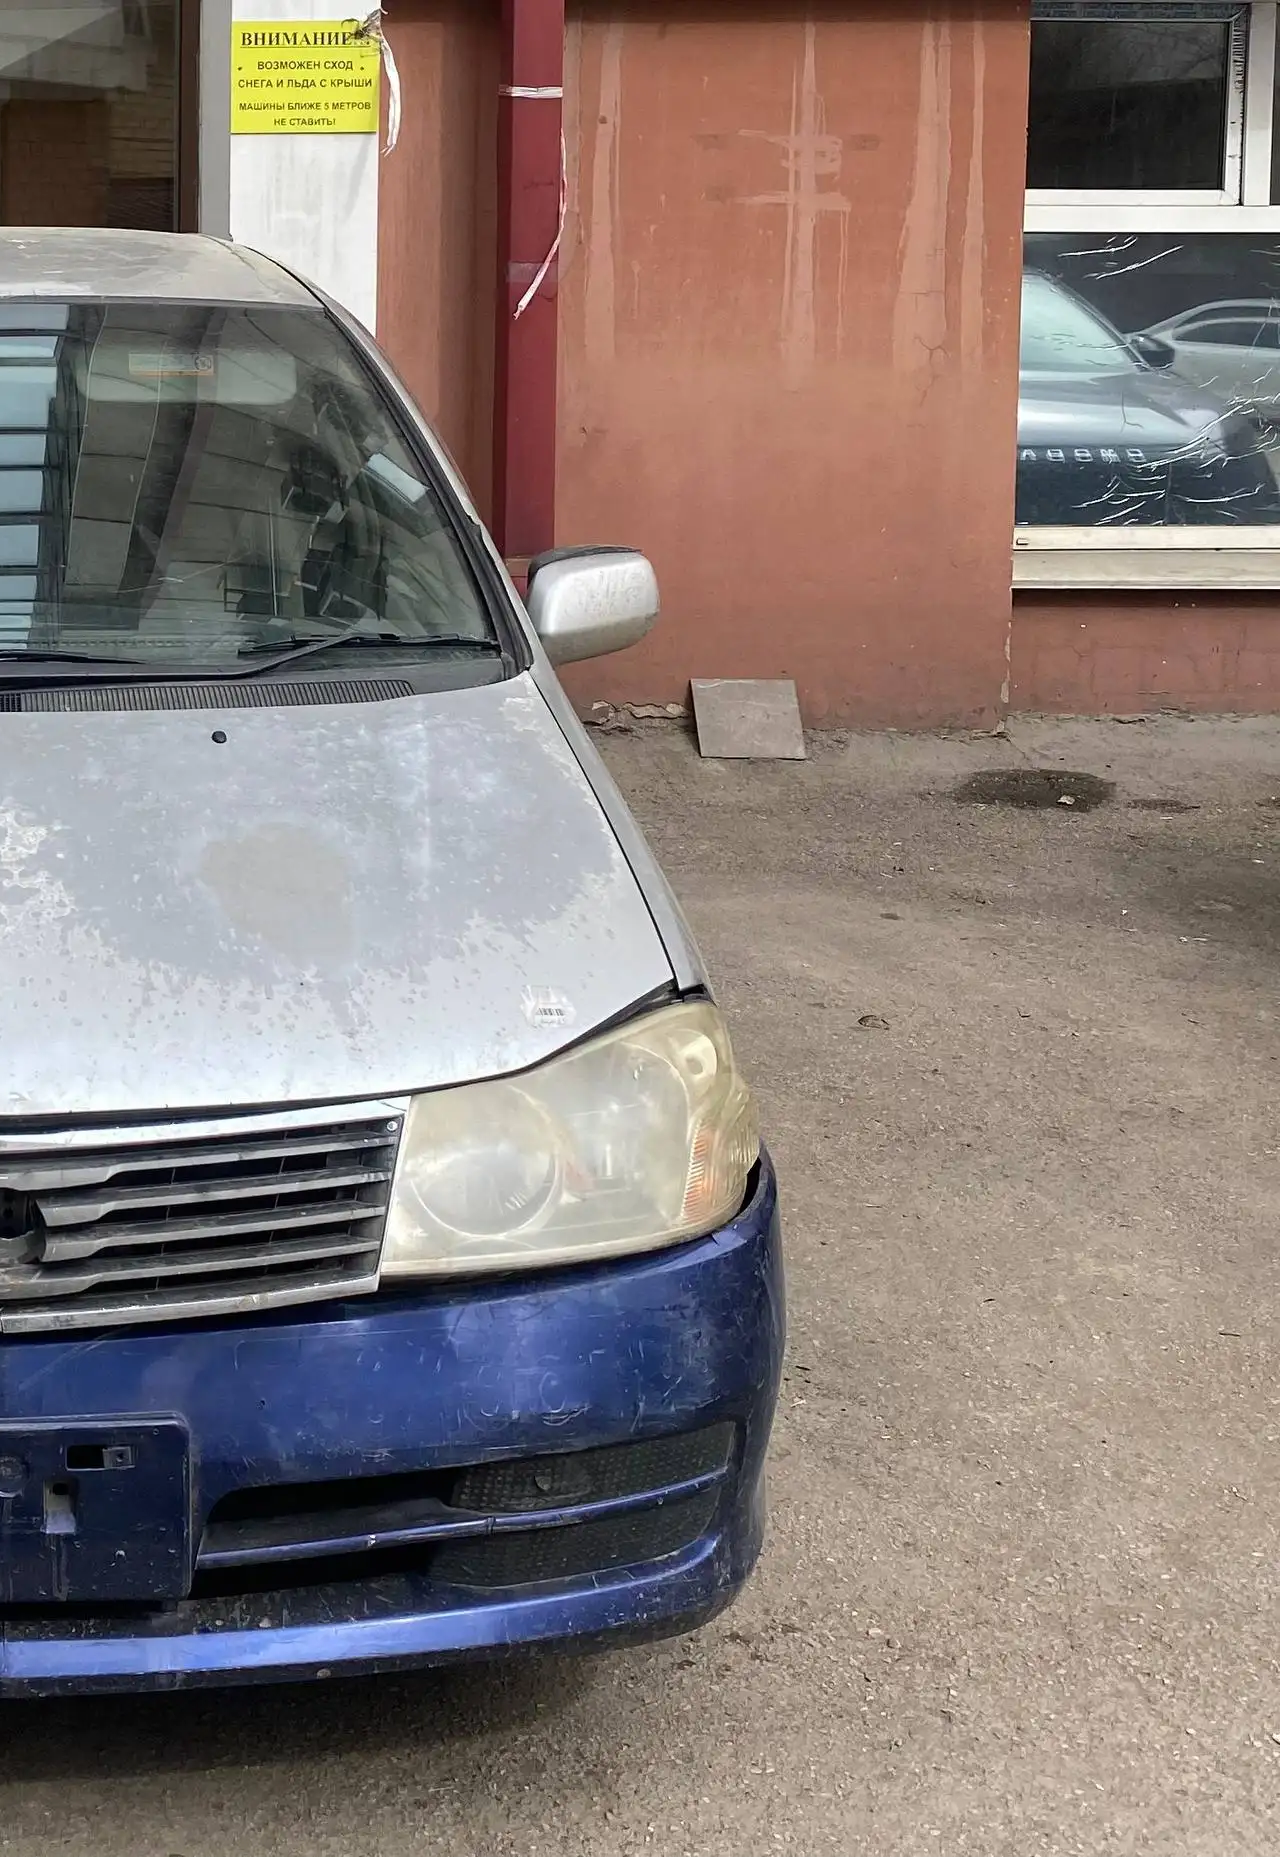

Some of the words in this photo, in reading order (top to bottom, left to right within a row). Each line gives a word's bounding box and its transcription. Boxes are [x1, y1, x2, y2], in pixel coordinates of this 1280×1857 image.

[241, 31, 370, 46] ВНИМАНИЕ
[257, 60, 320, 70] ВОЗМОЖЕН
[323, 60, 354, 71] СХОД
[237, 79, 273, 89] СНЕГА
[276, 79, 284, 88] И
[286, 79, 317, 89] ЛЬДА
[319, 79, 327, 88] С
[330, 78, 372, 88] КРЫШИ
[239, 102, 285, 111] МАШИНЫ
[287, 102, 321, 111] БЛИЖЕ
[323, 102, 330, 111] 5
[331, 101, 372, 111] МЕТРОВ
[273, 118, 287, 126] НЕ
[289, 117, 336, 126] СТАВИТЬ!
